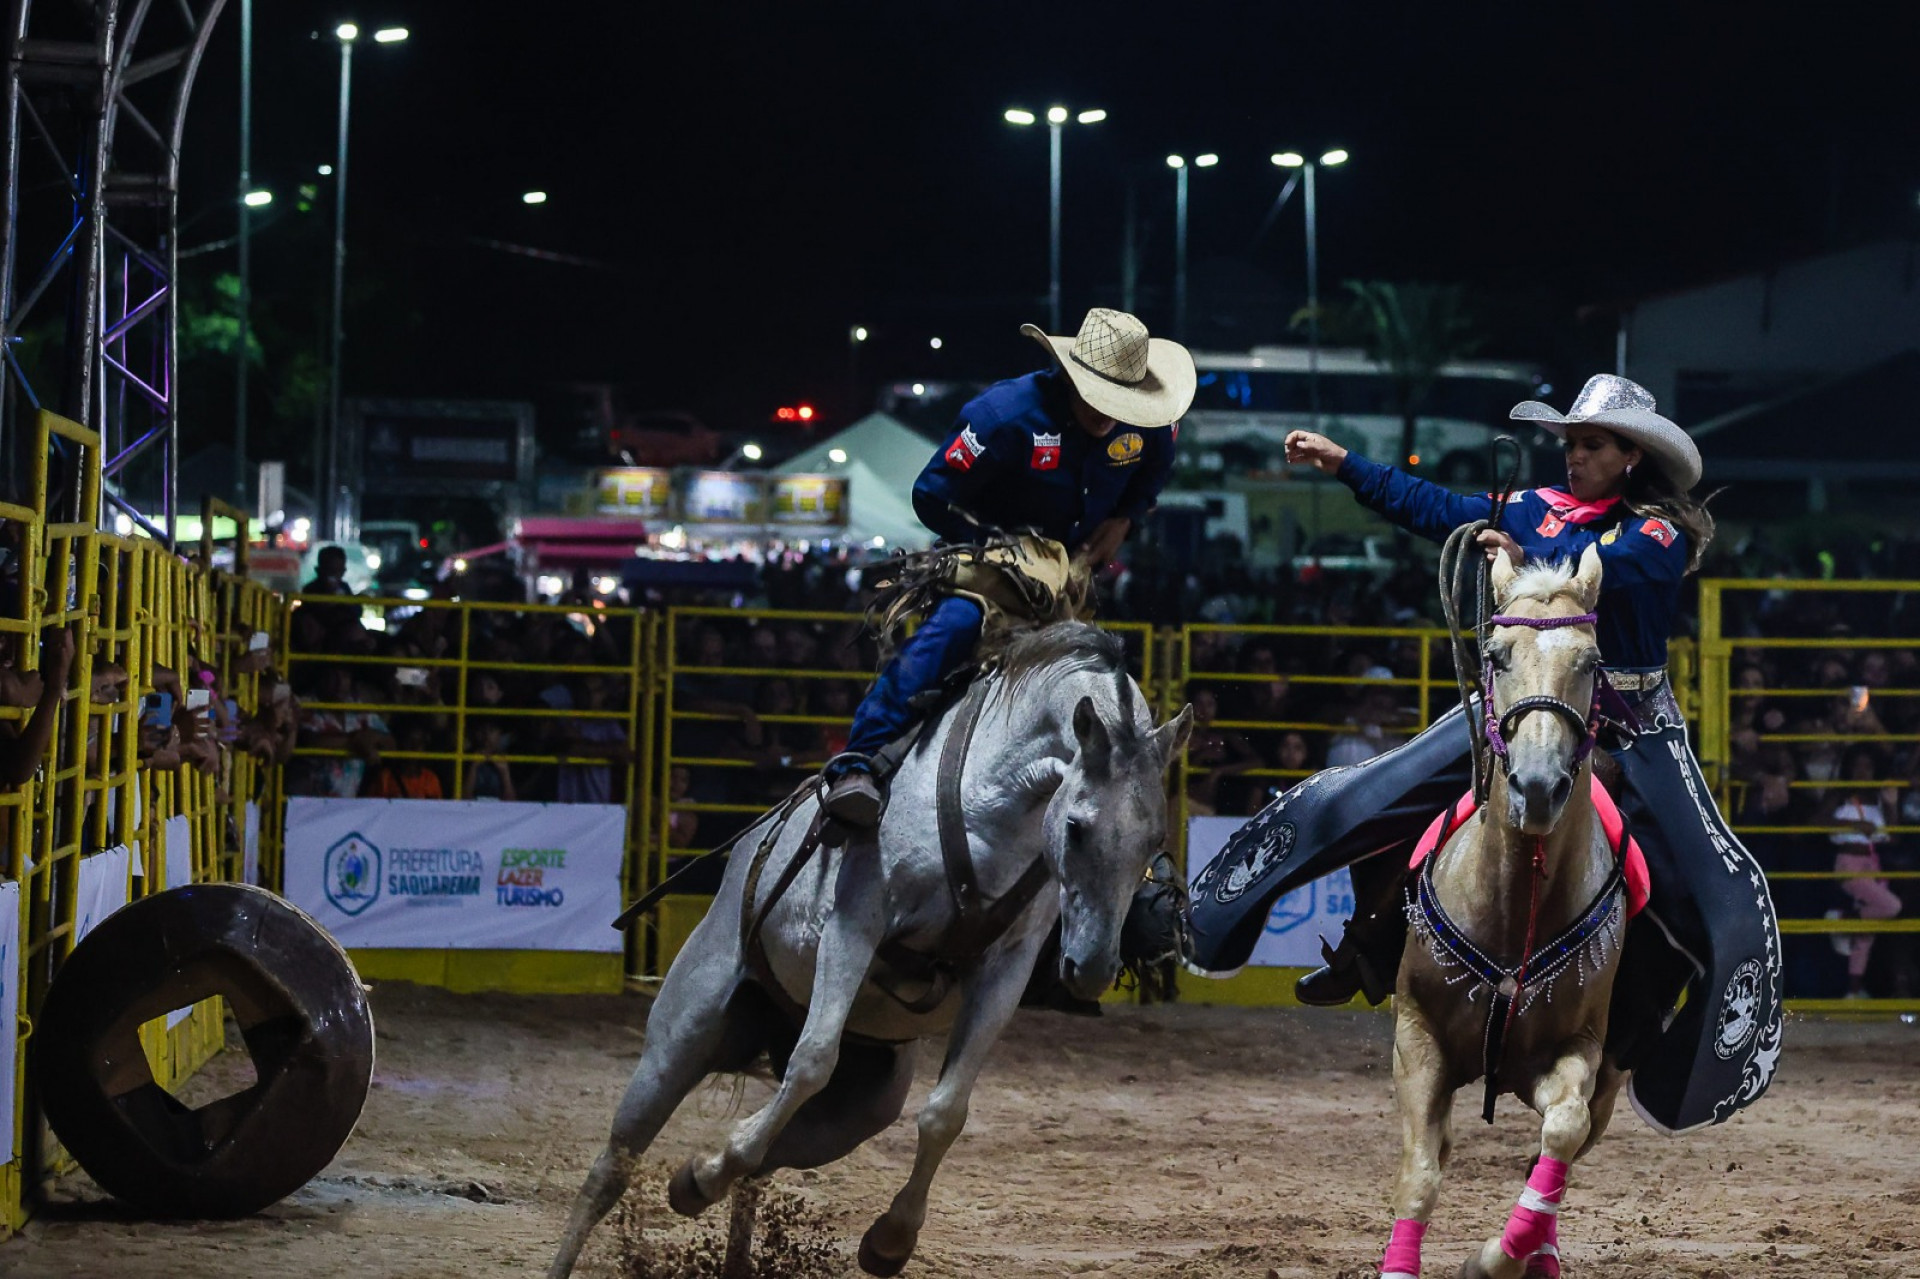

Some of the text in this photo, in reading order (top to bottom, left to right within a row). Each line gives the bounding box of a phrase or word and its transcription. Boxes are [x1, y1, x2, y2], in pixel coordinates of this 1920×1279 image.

[389, 847, 483, 872] PREFEITURA
[501, 847, 566, 868] ESPORTE
[389, 873, 480, 895] SAQUAREMA
[498, 867, 543, 887] LAZER
[497, 886, 564, 907] TURISMO
